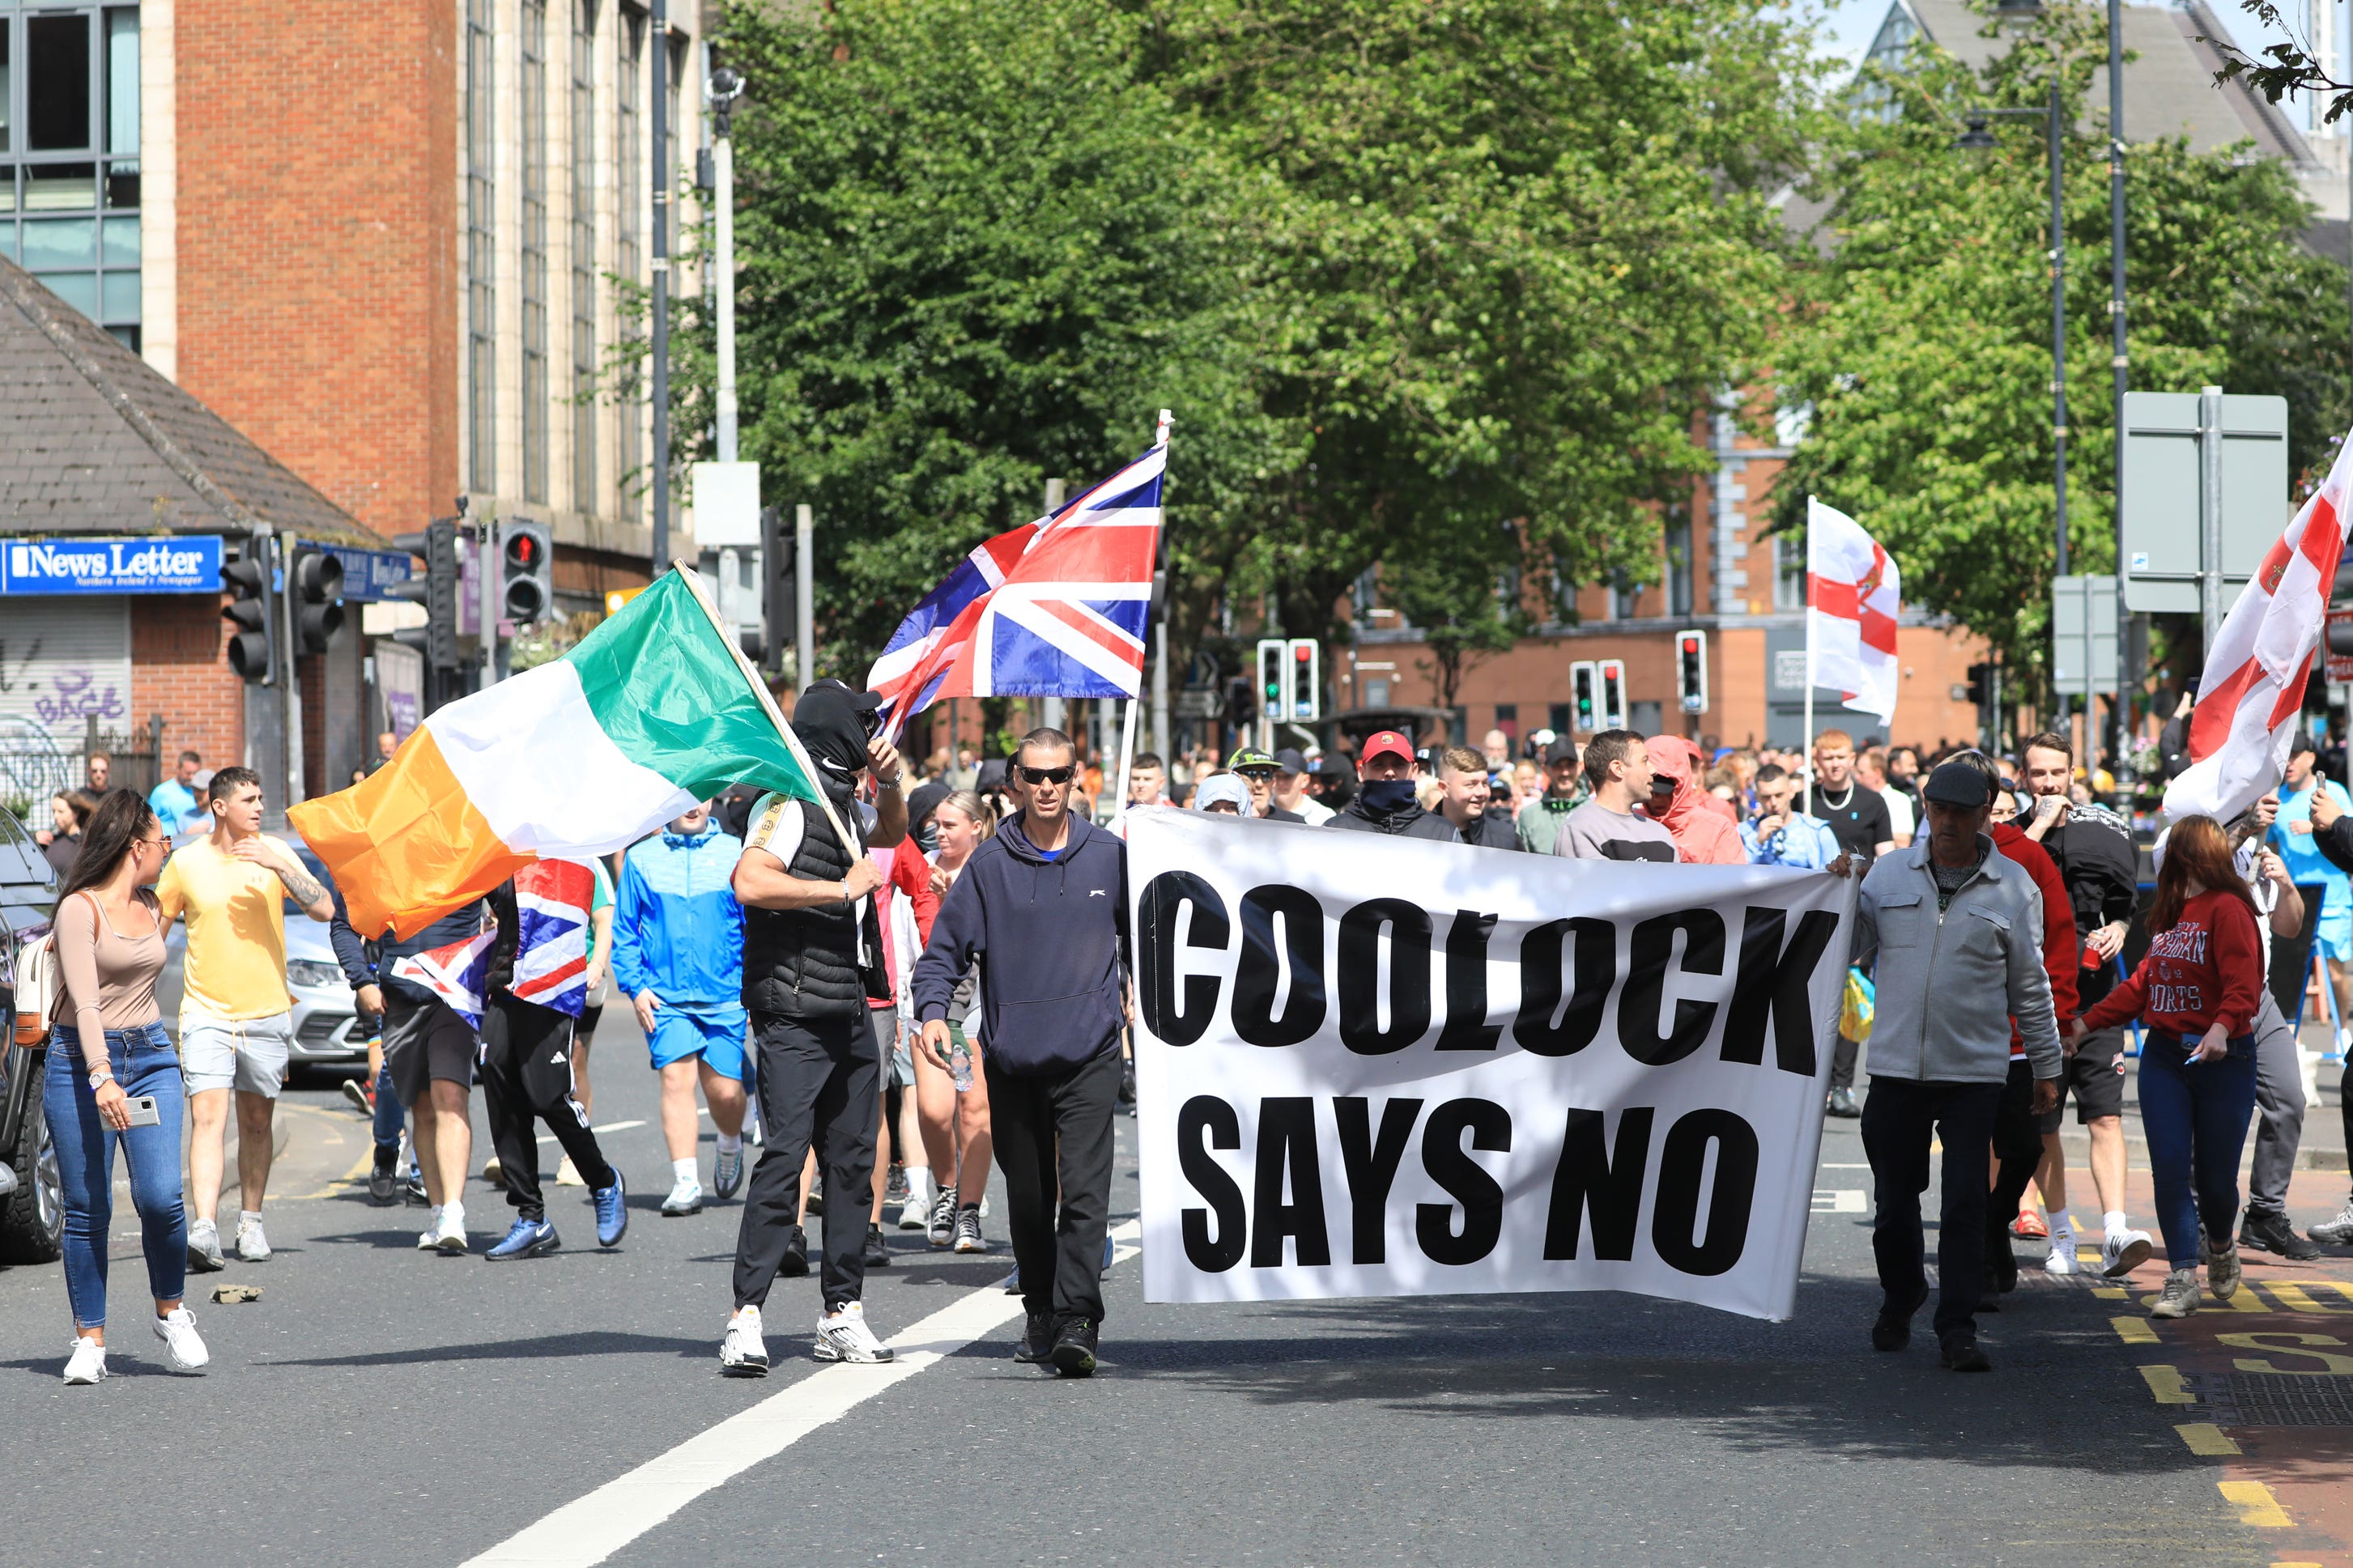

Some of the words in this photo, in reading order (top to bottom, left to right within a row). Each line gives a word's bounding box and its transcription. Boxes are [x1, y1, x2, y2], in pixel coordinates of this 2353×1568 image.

[29, 545, 107, 577] News
[110, 544, 203, 576] Letter
[1138, 870, 1840, 1077] COOLOCK
[1177, 1094, 1512, 1273] SAYS
[1543, 1107, 1759, 1277] NO
